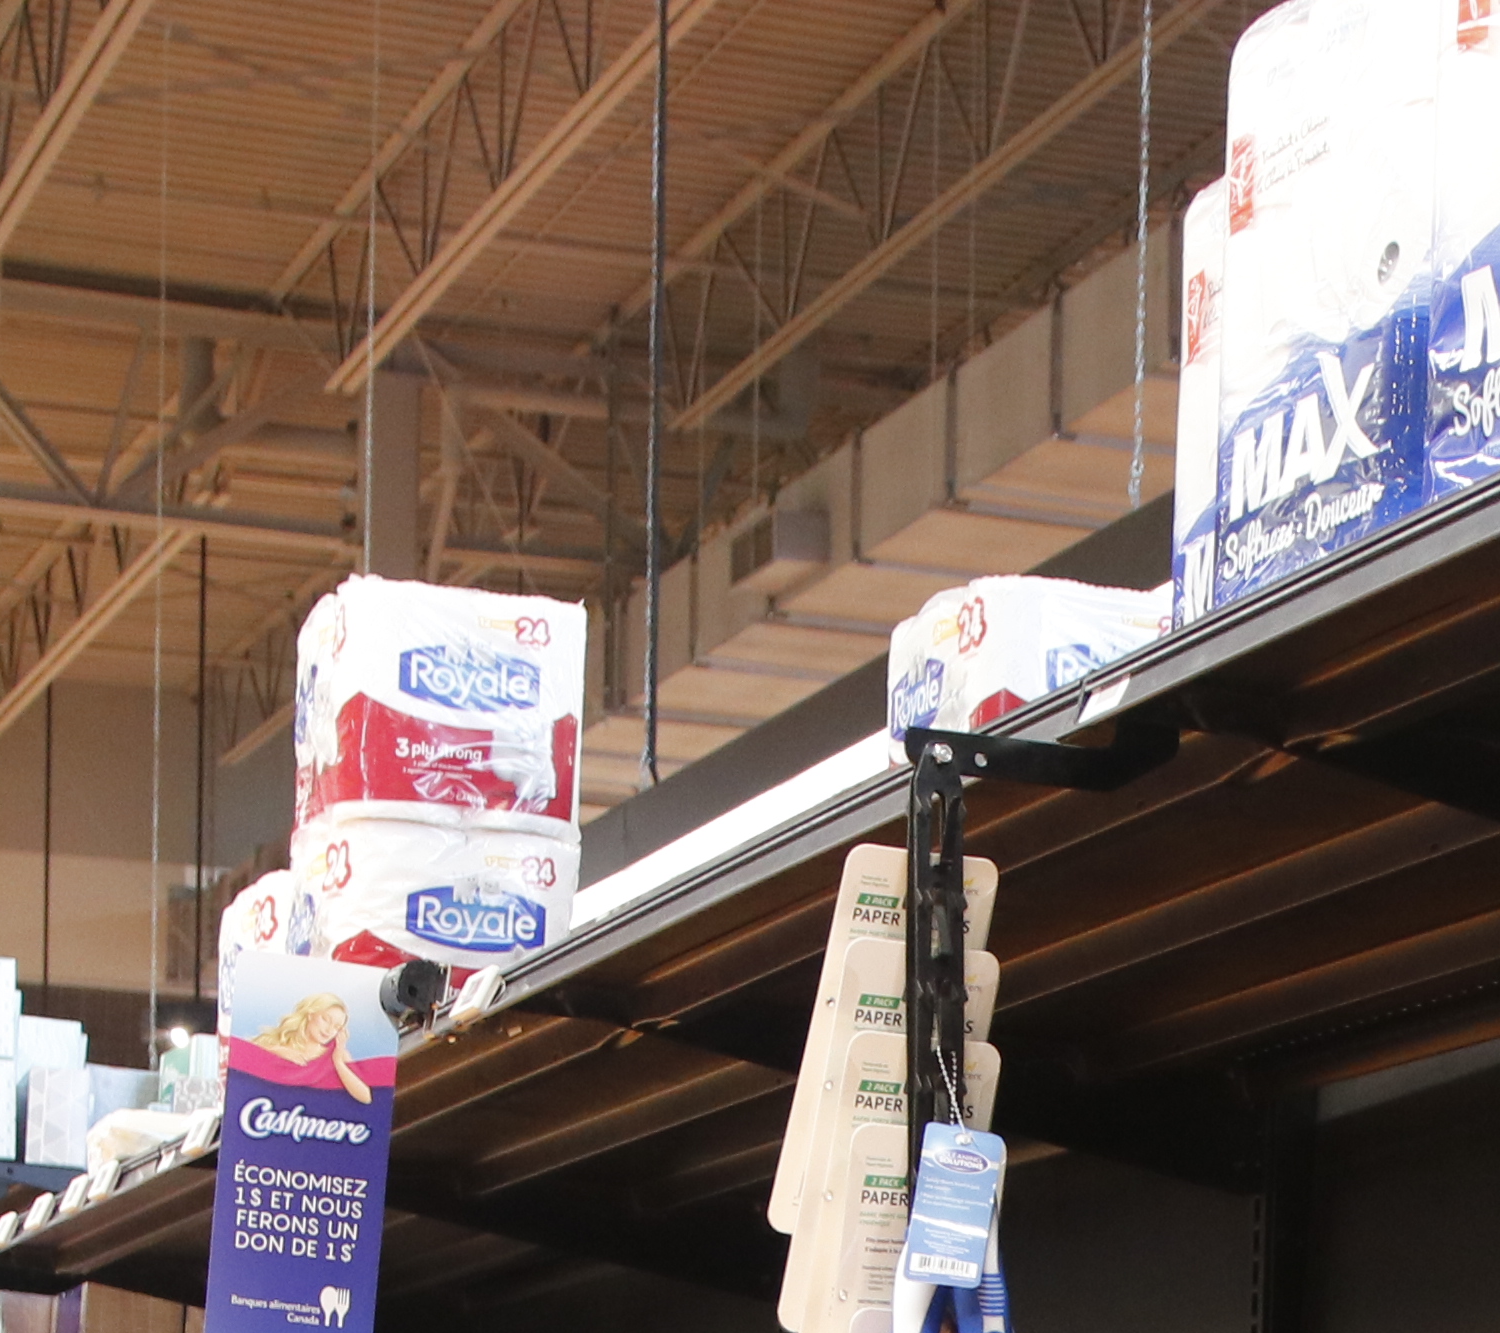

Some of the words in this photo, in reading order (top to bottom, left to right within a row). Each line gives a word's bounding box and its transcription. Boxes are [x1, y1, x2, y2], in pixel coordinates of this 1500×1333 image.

[1230, 351, 1387, 523] MAX
[1223, 519, 1296, 580] Softness
[1304, 482, 1385, 540] Douceur
[515, 616, 551, 648] 24
[958, 596, 987, 653] 24
[409, 653, 532, 701] Royale
[395, 738, 409, 758] 3
[411, 741, 435, 763] ply
[522, 856, 556, 887] 24
[417, 895, 537, 945] Royale
[852, 907, 901, 927] PAPER
[854, 1008, 903, 1028] PAPER
[855, 1094, 904, 1114] PAPER
[239, 1097, 372, 1145] Cashmere
[234, 1158, 368, 1198] ÉCONOMISEZ
[270, 1190, 294, 1210] ET
[301, 1194, 362, 1219] NOUS
[861, 1189, 909, 1208] PAPER
[236, 1208, 319, 1236] FERONS
[328, 1219, 358, 1241] UN
[235, 1230, 284, 1254] DON
[291, 1237, 318, 1258] DE
[231, 1293, 267, 1310] Banques
[269, 1297, 321, 1315] alimentaires
[287, 1311, 320, 1326] Canada
